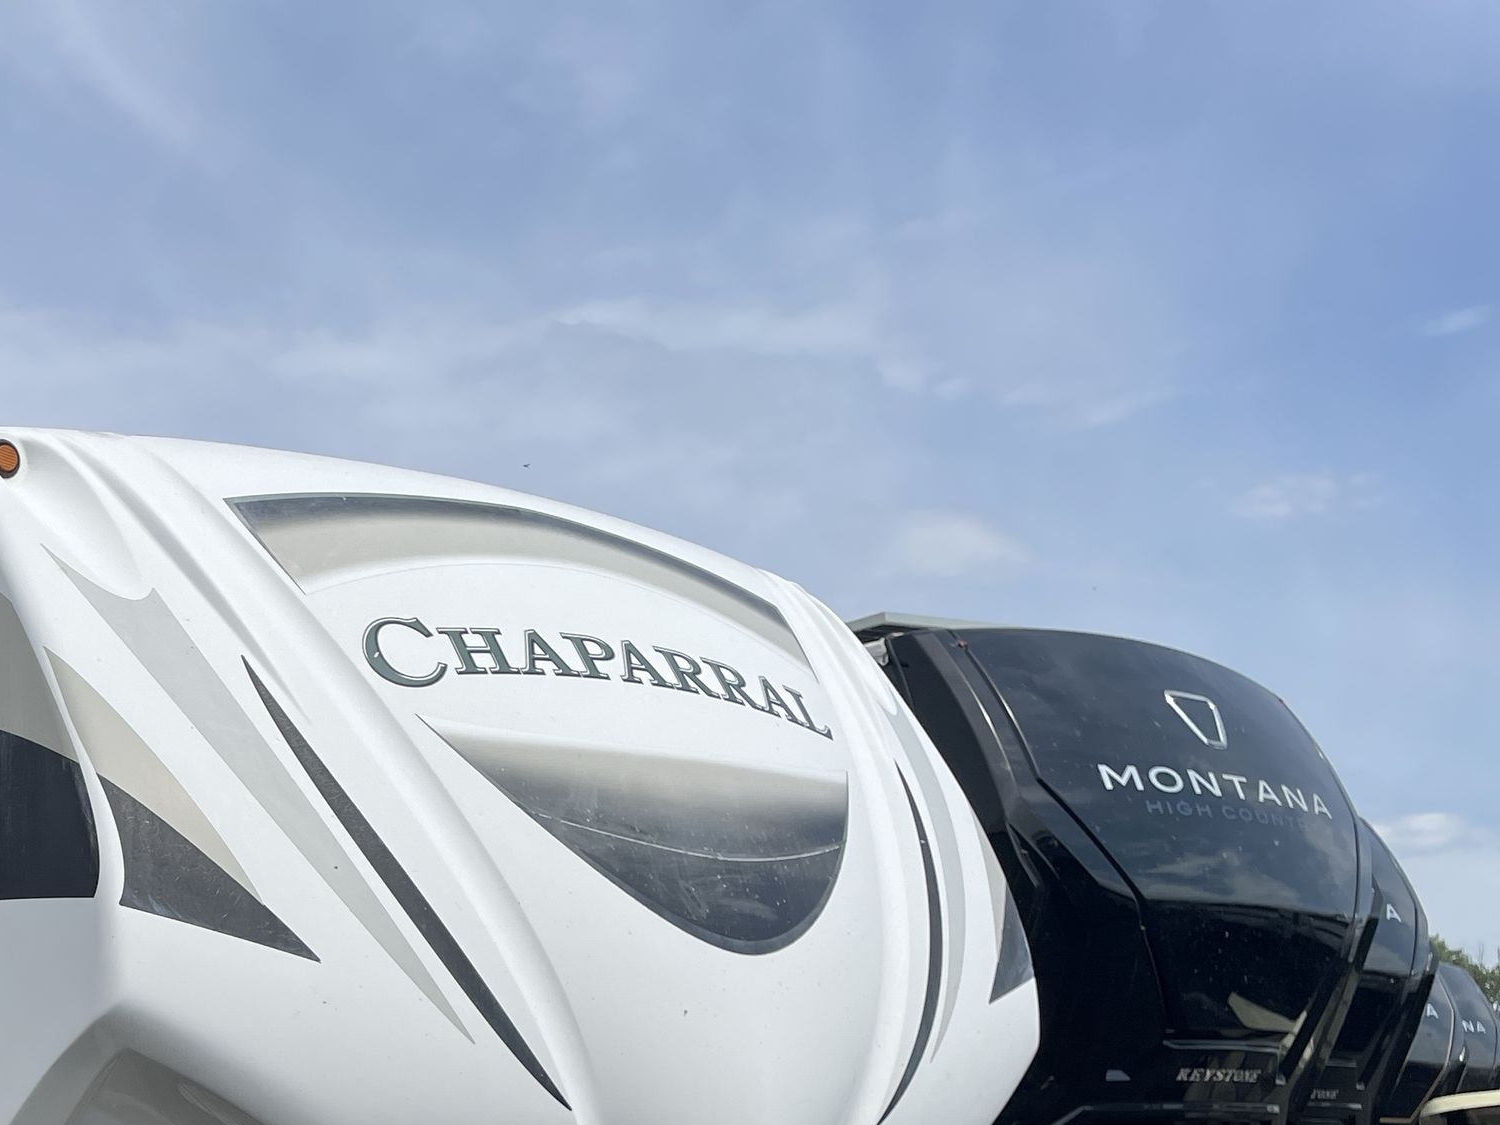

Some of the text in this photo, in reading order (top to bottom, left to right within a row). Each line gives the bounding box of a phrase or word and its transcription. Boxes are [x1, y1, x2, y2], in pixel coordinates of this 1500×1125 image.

[362, 616, 834, 741] CHAPARRAL
[1097, 763, 1333, 819] MONTANA
[1145, 799, 1213, 818] HIGH
